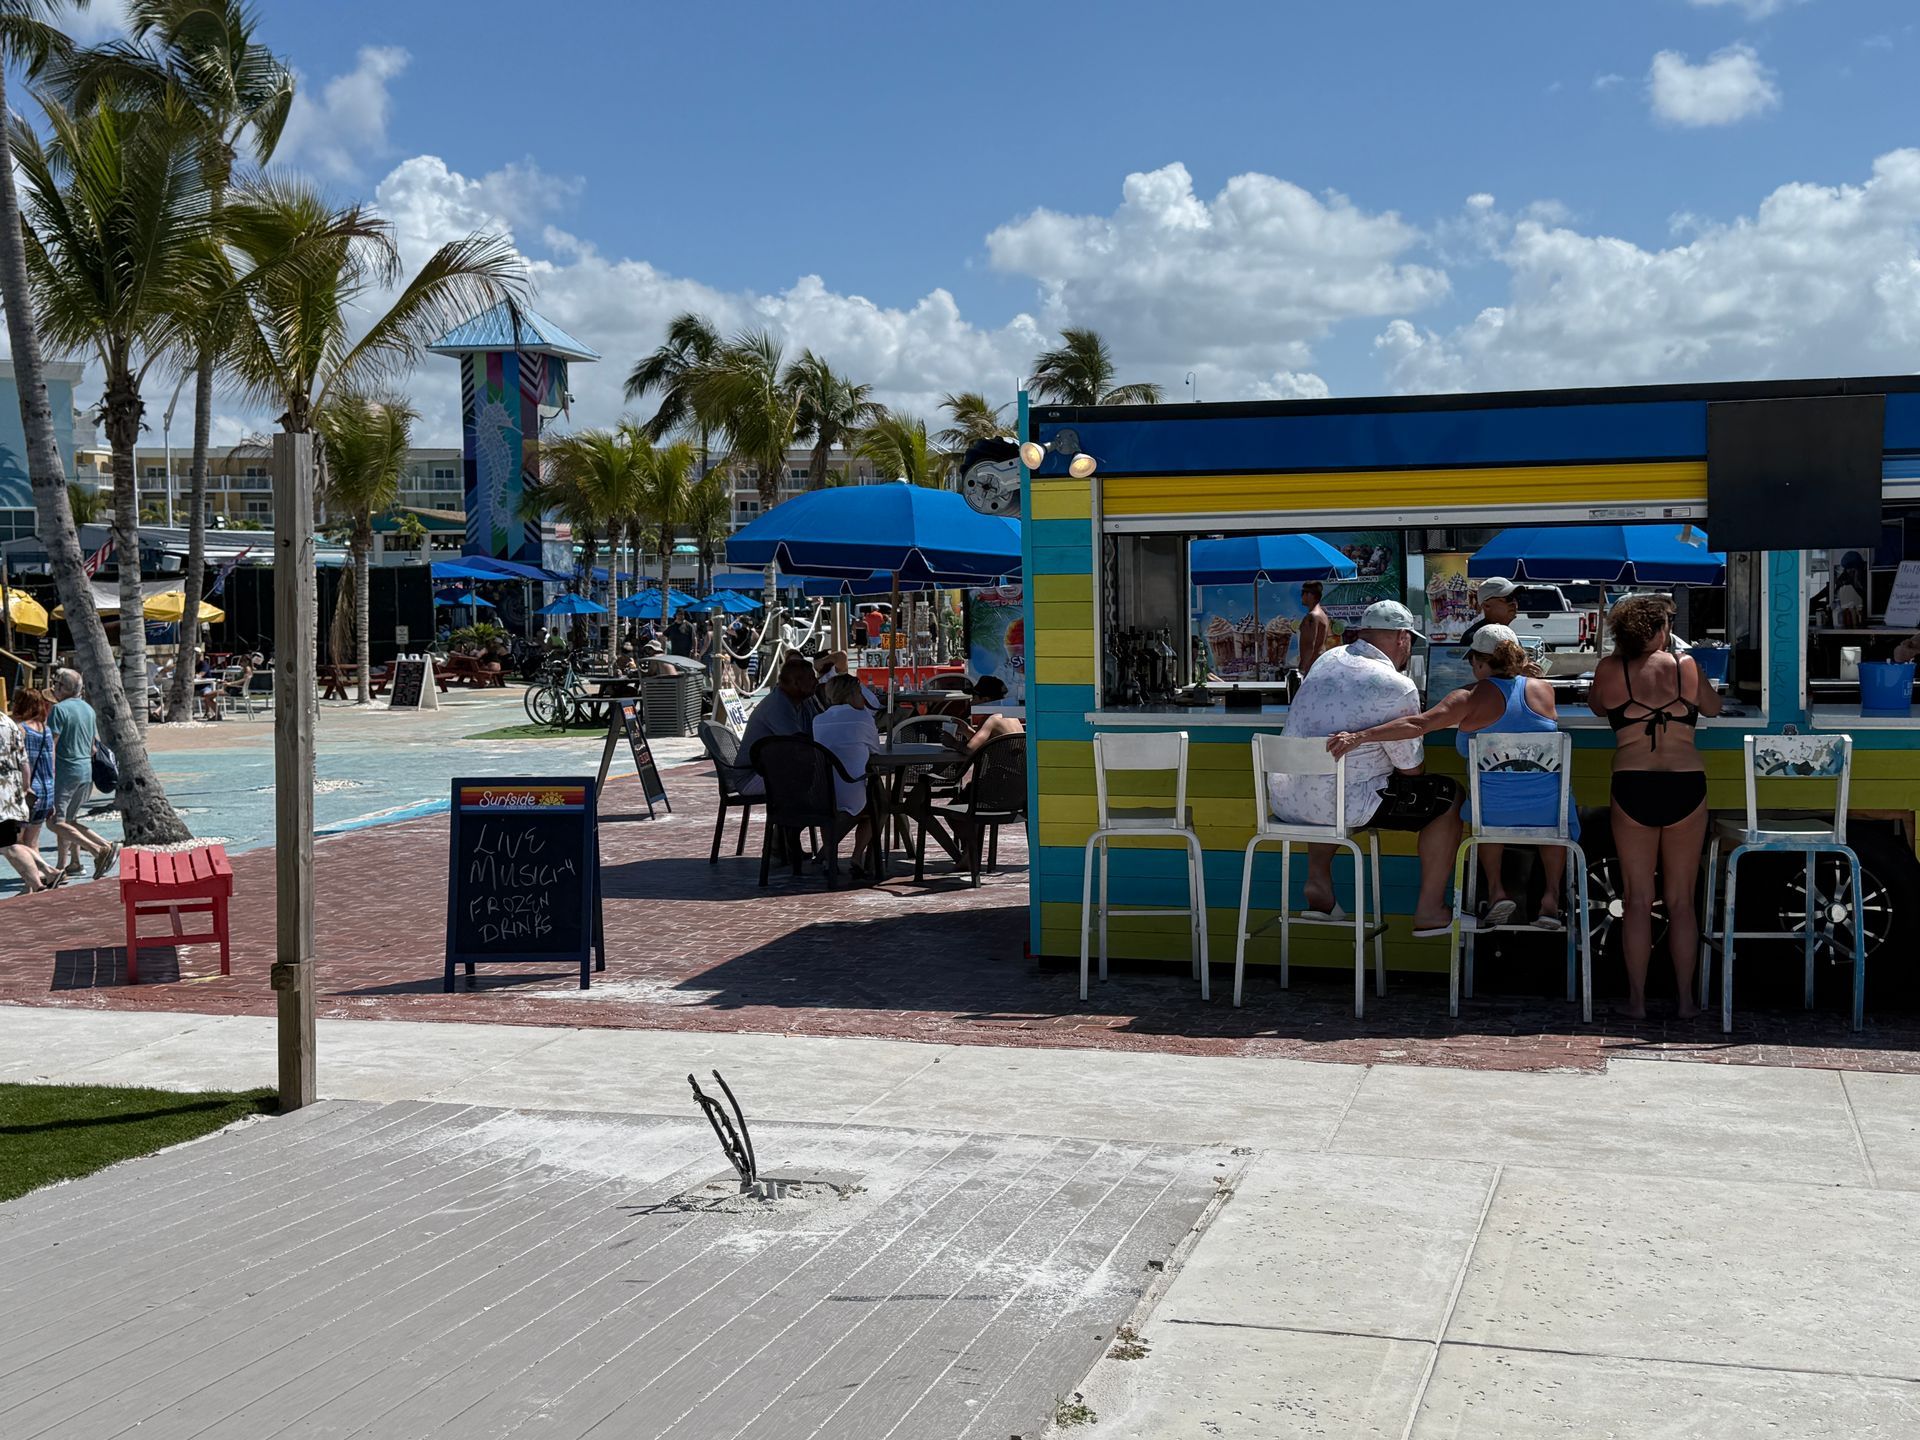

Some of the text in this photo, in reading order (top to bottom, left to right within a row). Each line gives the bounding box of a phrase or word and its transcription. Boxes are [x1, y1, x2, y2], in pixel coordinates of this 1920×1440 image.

[729, 705, 748, 726] ICE
[479, 791, 536, 808] Surfside
[473, 823, 545, 859] LIVE
[470, 855, 554, 890] MUSIC
[470, 892, 550, 922] FROZEN
[478, 914, 553, 943] DRINKS
